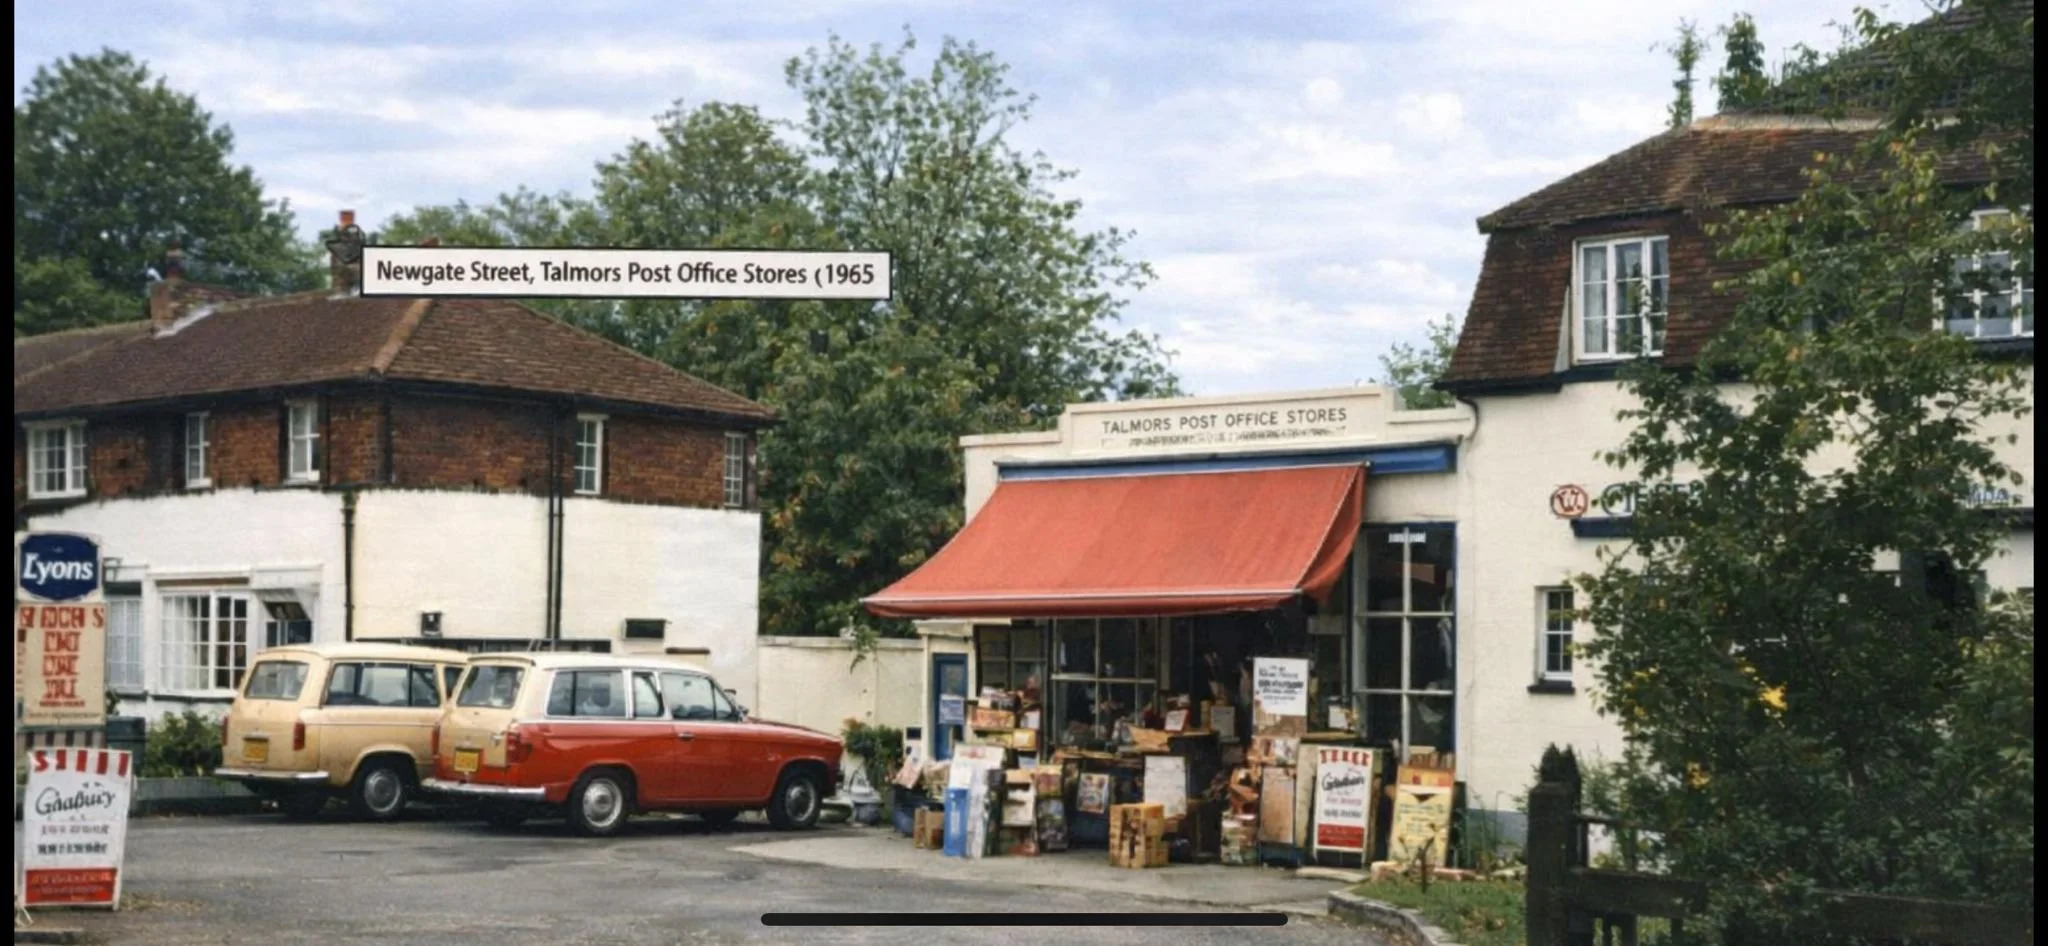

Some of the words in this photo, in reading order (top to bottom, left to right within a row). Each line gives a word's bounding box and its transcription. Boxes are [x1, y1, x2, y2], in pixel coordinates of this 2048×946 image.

[1101, 417, 1172, 434] TALMORS
[1179, 414, 1218, 430] POST
[1225, 410, 1279, 428] OFFICE
[1286, 407, 1347, 424] STORES
[22, 552, 94, 586] Lyons
